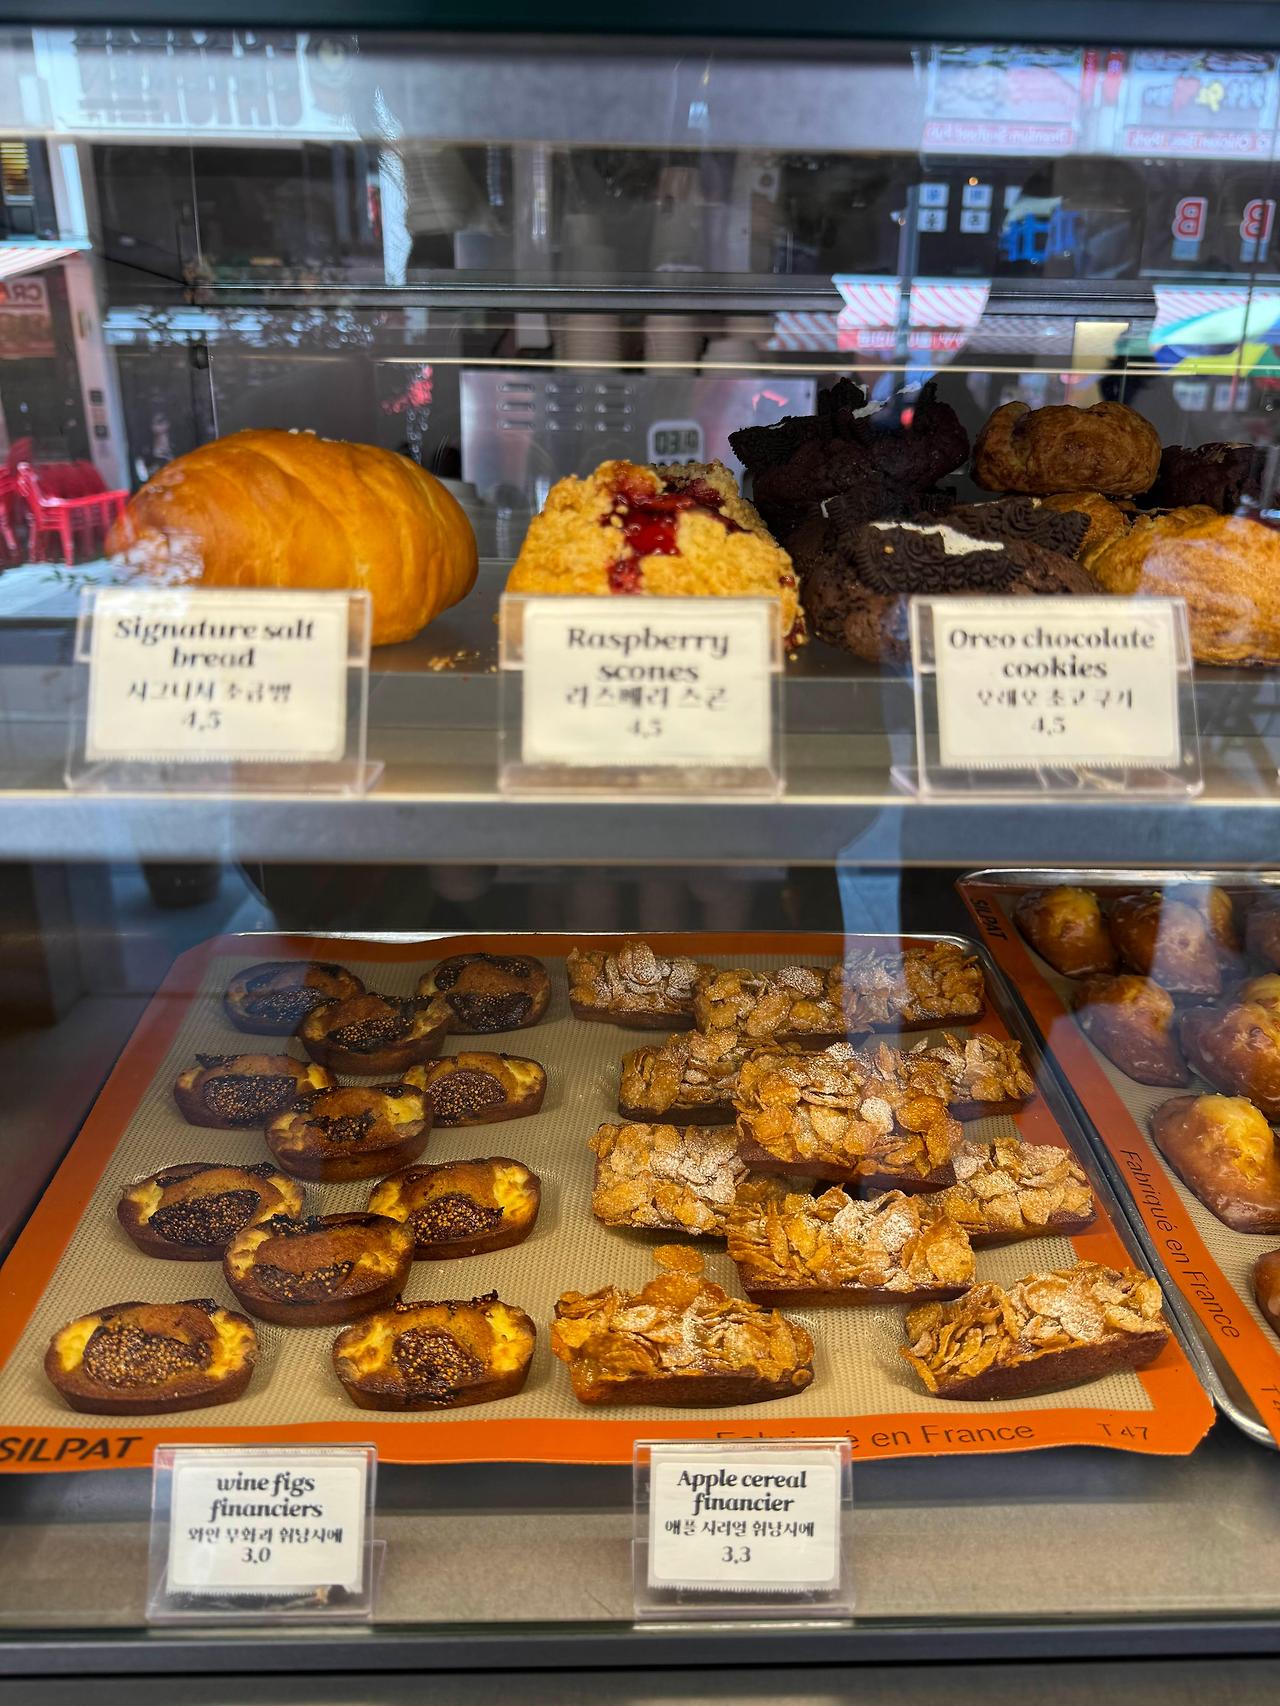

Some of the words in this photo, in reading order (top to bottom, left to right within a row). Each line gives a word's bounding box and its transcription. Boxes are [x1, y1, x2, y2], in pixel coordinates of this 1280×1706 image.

[115, 616, 258, 645] Signature
[264, 617, 315, 639] salt
[949, 628, 1016, 649] Oreo
[1023, 627, 1155, 650] chocolate
[567, 627, 729, 660] Raspberry
[171, 646, 256, 668] bread
[1003, 655, 1108, 679] cookies
[599, 664, 699, 682] scones
[1120, 1149, 1178, 1232] Fabriqué
[1166, 1239, 1190, 1264] en
[1183, 1271, 1240, 1338] France
[871, 1430, 912, 1448] en
[920, 1424, 1035, 1444] France
[0, 1436, 144, 1462] SILPAT
[217, 1472, 270, 1493] wine
[273, 1471, 315, 1496] figs
[677, 1469, 738, 1494] Apple
[741, 1470, 808, 1489] cereal
[210, 1498, 323, 1522] financiers
[691, 1492, 795, 1516] financier
[187, 1526, 221, 1545] 와인
[278, 1527, 344, 1545] 휘낭시에
[665, 1519, 697, 1537] 애플
[701, 1519, 748, 1537] 시리얼
[753, 1521, 815, 1538] 휘낭시에
